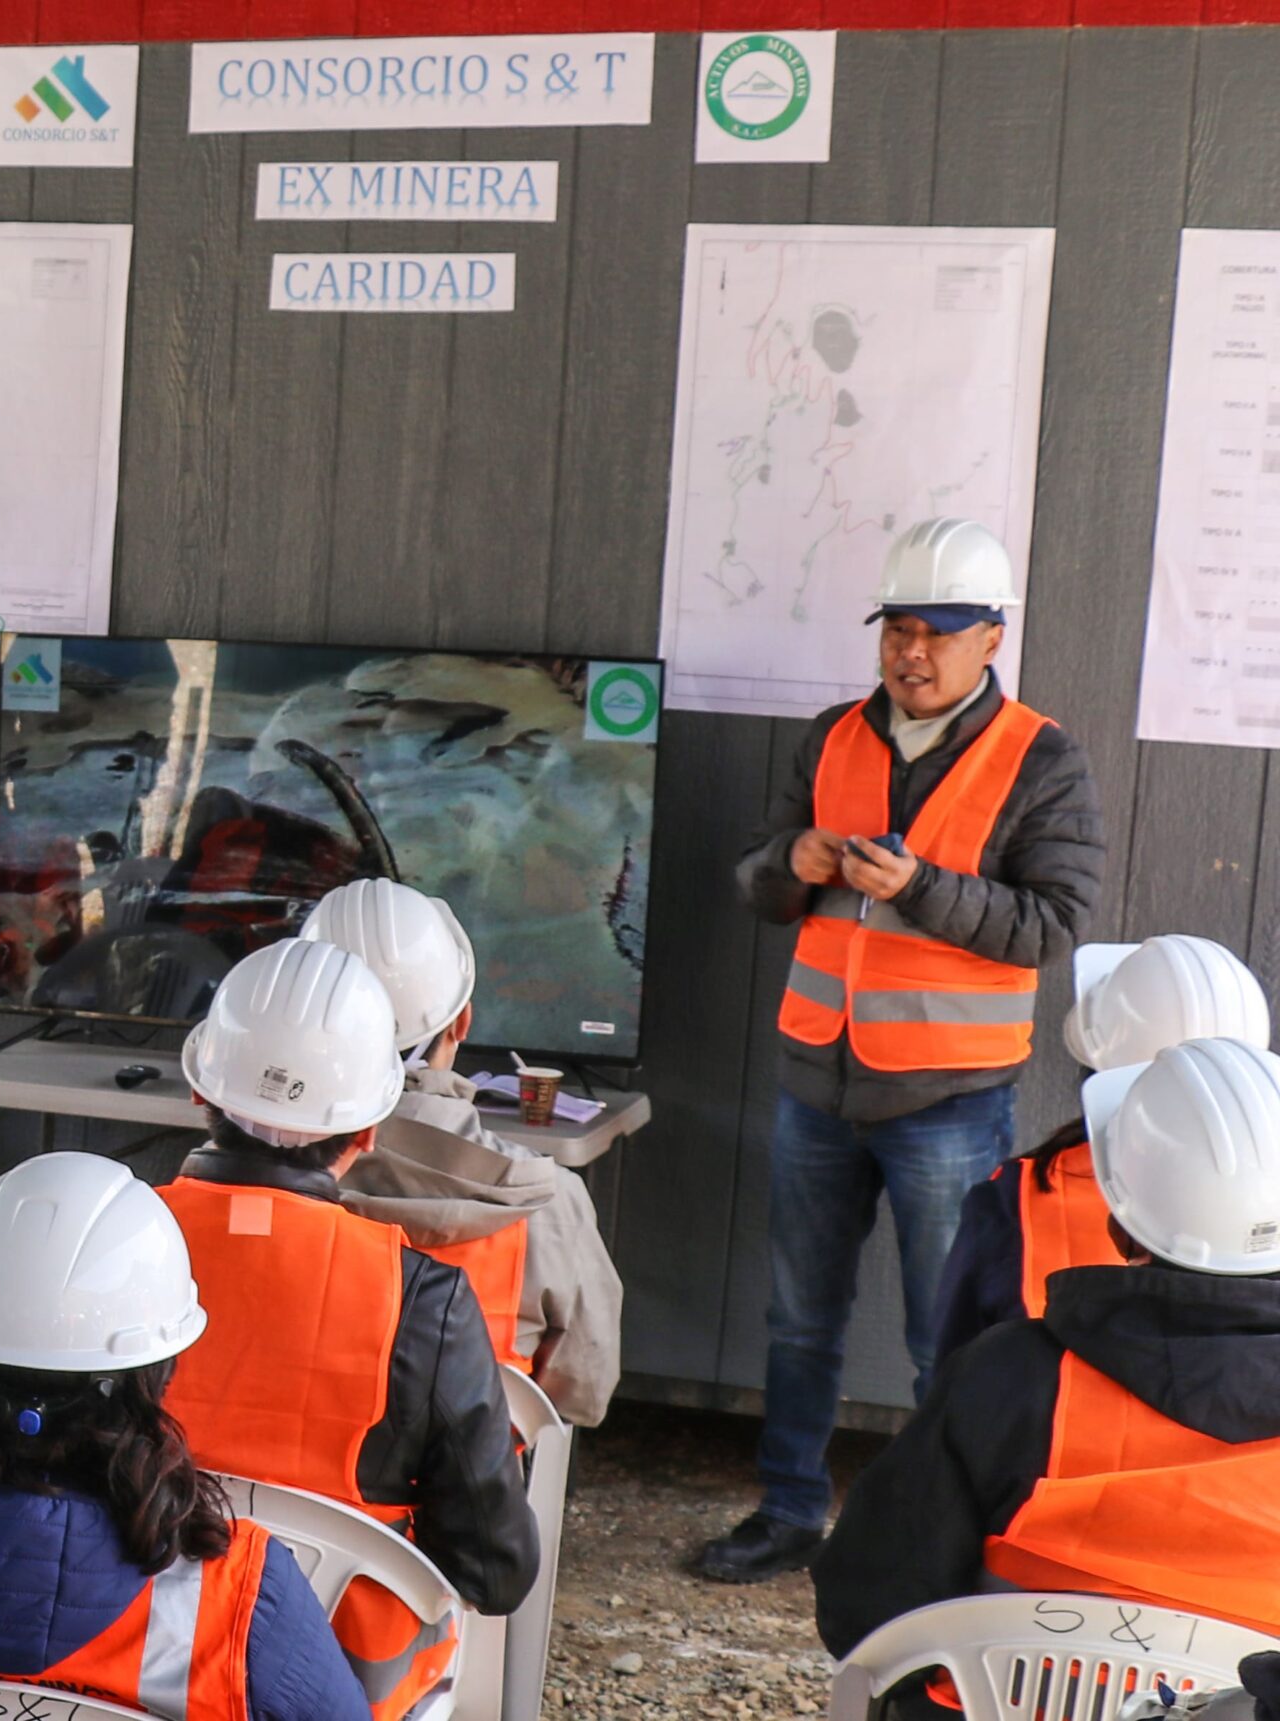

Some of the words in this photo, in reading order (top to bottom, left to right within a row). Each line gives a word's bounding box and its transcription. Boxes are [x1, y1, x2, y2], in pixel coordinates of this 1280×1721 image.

[219, 54, 489, 100] CONSORCIO
[505, 54, 530, 96] S
[544, 52, 579, 96] &
[595, 51, 627, 93] T
[708, 40, 750, 98] ACTIVOS
[766, 38, 808, 97] MINEROS
[2, 127, 86, 142] CONSORCIO
[89, 127, 120, 142] S&T
[731, 124, 767, 138] S.A.C.
[277, 166, 334, 206] EX
[348, 166, 540, 206] MINERA
[284, 260, 497, 301] CARIDAD
